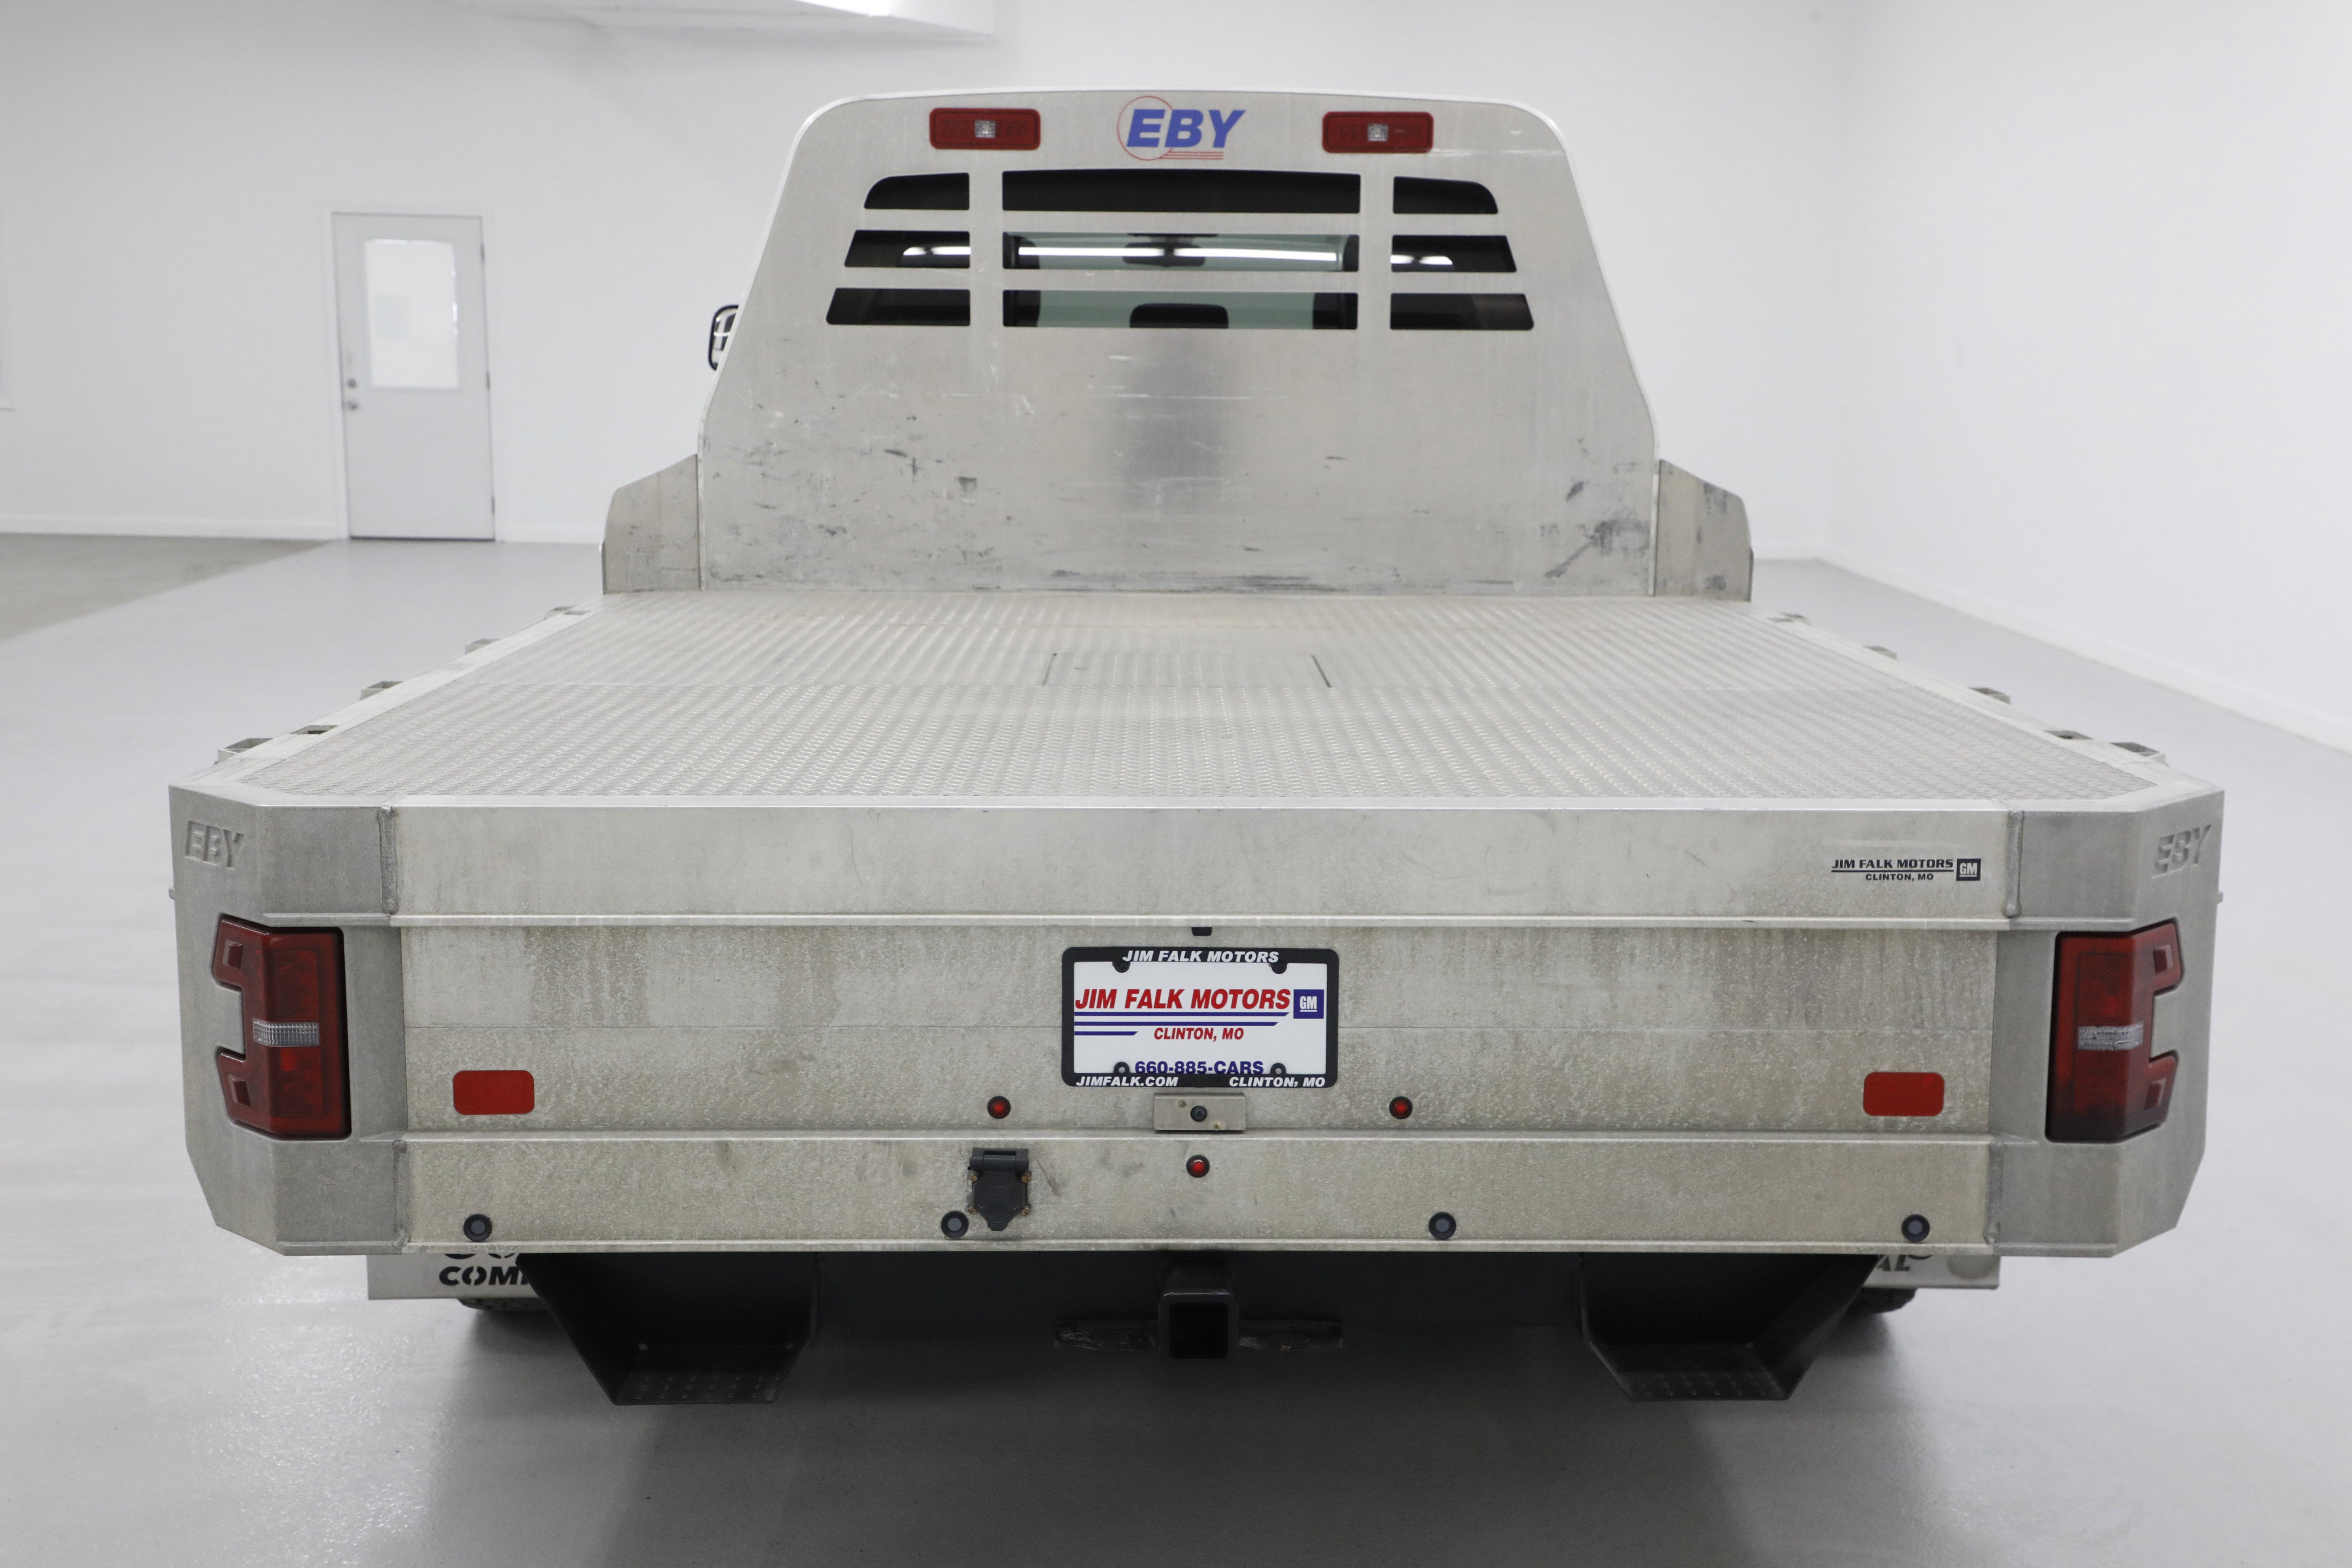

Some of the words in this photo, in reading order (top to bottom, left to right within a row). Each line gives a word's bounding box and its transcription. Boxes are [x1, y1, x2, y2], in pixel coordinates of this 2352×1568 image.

[1126, 109, 1247, 148] EBY
[185, 820, 245, 870] EBY
[2152, 824, 2212, 878] EBY
[1832, 859, 1855, 869] JIM
[1859, 859, 1893, 869] FALK
[1897, 859, 1953, 869] MOTORS
[1959, 862, 1978, 875] GM
[1865, 873, 1915, 882] CLINTON,
[1918, 873, 1934, 881] MO
[1122, 950, 1153, 962] JIM
[1158, 950, 1202, 962] FALK
[1207, 951, 1279, 963] MOTORS
[1075, 989, 1118, 1009] JIM
[1124, 989, 1185, 1009] FALK
[1190, 989, 1291, 1010] MOTORS
[1299, 996, 1318, 1010] GM
[1154, 1027, 1218, 1042] CLINTON,
[1222, 1027, 1244, 1040] MO
[1134, 1061, 1264, 1075] 660-885-CARS
[1076, 1076, 1179, 1087] JIMFALK.COM
[1229, 1076, 1298, 1087] CLINTON,
[1302, 1076, 1326, 1087] MO
